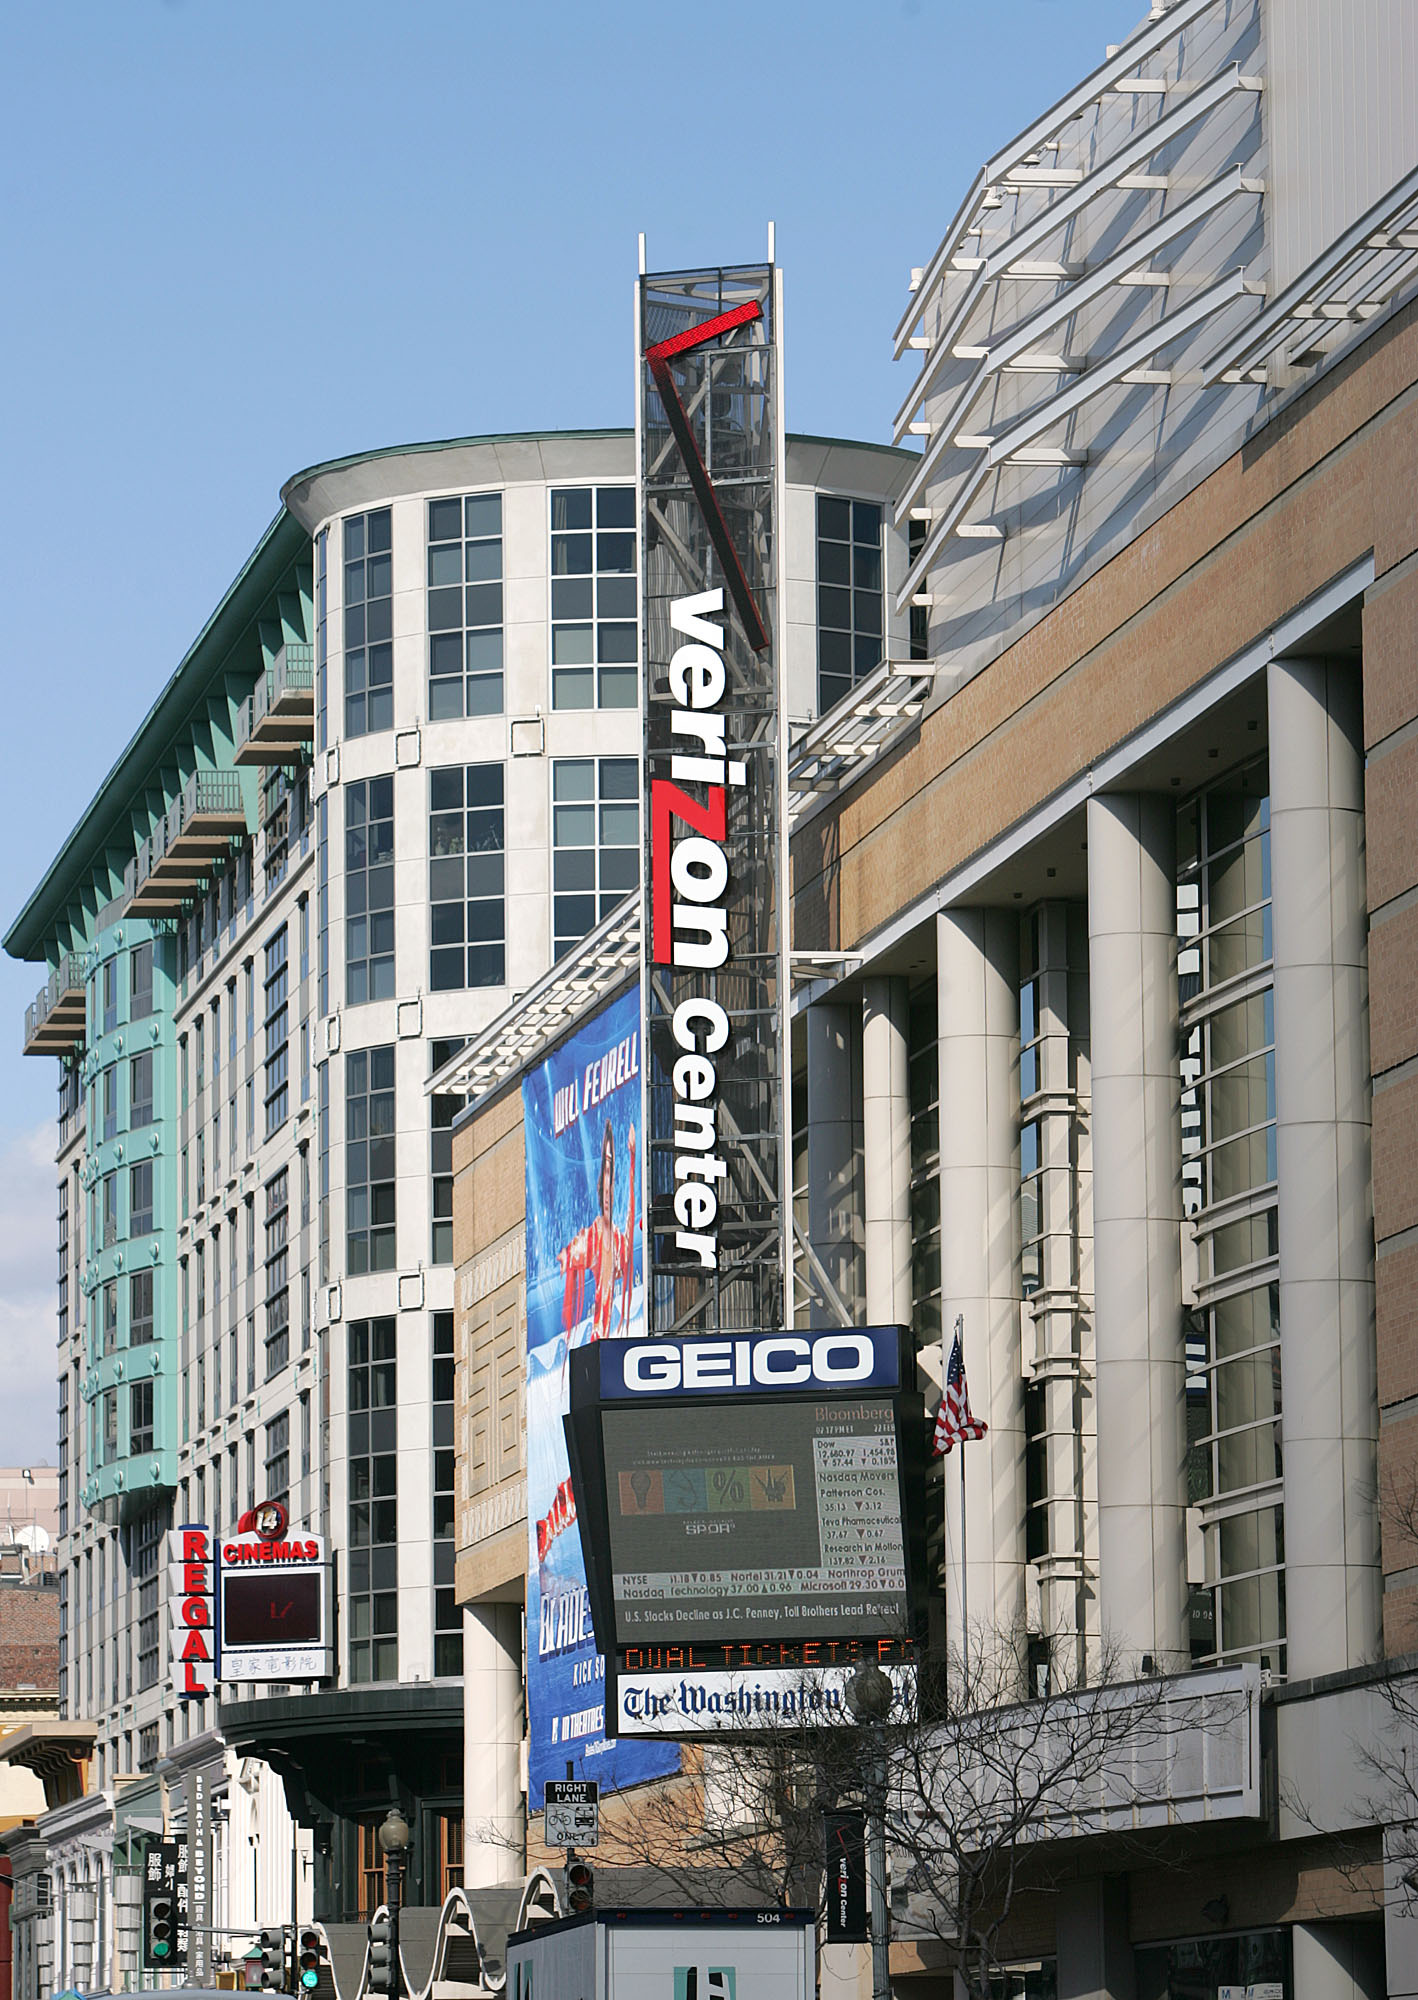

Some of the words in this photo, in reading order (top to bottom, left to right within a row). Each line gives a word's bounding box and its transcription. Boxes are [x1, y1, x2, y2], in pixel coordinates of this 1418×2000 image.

[652, 588, 747, 969] verizon
[554, 1079, 579, 1136] WILL
[583, 1031, 639, 1113] FERRELL
[673, 998, 730, 1268] Center
[623, 1334, 874, 1391] GEICO
[816, 1405, 894, 1423] Bloomberg
[817, 1440, 836, 1449] Dow
[820, 1473, 857, 1484] Nasdaq
[860, 1471, 895, 1481] Movers
[820, 1488, 863, 1498] Patterson
[865, 1487, 885, 1496] Cos.
[256, 1511, 277, 1531] 14
[822, 1517, 840, 1527] Teva
[223, 1540, 319, 1563] CINEMAS
[824, 1543, 863, 1553] Research
[874, 1542, 904, 1552] Motion
[622, 1575, 648, 1585] NYSE
[700, 1573, 722, 1582] 0.85
[731, 1571, 762, 1582] Nortel
[796, 1569, 819, 1579] 0.04
[828, 1568, 875, 1581] Northrop
[623, 1588, 665, 1599] Nasdaq
[731, 1584, 760, 1593] 37.00
[770, 1583, 792, 1592] 0.96
[801, 1580, 847, 1592] Microsoft
[850, 1580, 878, 1590] 29.30
[182, 1531, 208, 1692] REGAL
[625, 1611, 642, 1622] U.S.
[644, 1610, 674, 1622] Stocks
[676, 1609, 710, 1621] Decline
[712, 1611, 723, 1620] as
[726, 1608, 743, 1619] J.C.
[784, 1605, 799, 1617] Toll
[801, 1604, 838, 1617] Brothers
[841, 1603, 864, 1616] Lead
[626, 1647, 706, 1669] DUAL
[721, 1641, 863, 1666] TICKETS
[572, 1658, 593, 1688] KICK
[624, 1686, 672, 1721] The
[679, 1679, 840, 1719] Washington
[195, 1775, 203, 1800] BED
[554, 1783, 588, 1793] RIGHT
[556, 1793, 588, 1803] LANE
[195, 1802, 204, 1836] BATH
[195, 1838, 204, 1847] &
[556, 1831, 586, 1841] ONLY
[193, 1850, 206, 1900] BEYOND
[837, 1857, 849, 1897] verizon
[756, 1912, 781, 1924] 504
[840, 1899, 848, 1928] Center
